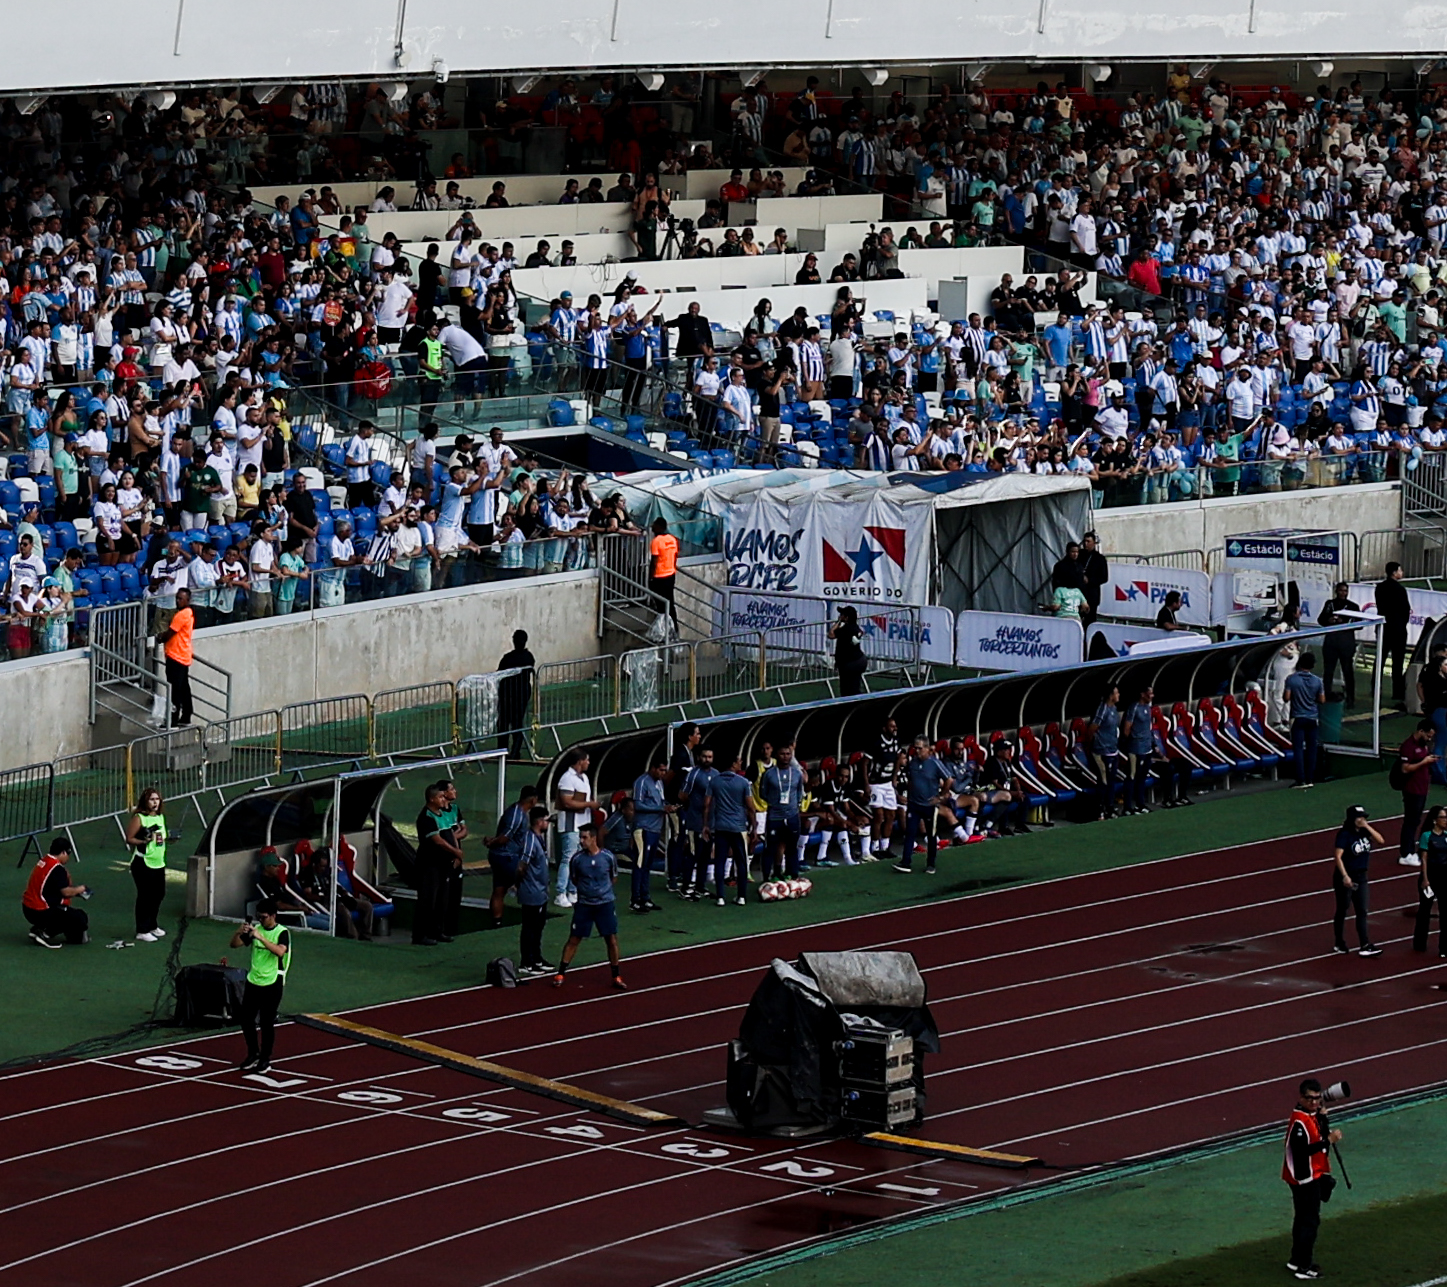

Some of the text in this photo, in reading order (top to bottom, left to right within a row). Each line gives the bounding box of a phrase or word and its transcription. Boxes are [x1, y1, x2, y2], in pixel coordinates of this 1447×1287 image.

[725, 528, 805, 564] VAMOS
[1244, 542, 1283, 556] Estácio
[1300, 549, 1334, 562] Estácio
[886, 587, 903, 598] DO
[996, 625, 1044, 643] #VAMOS
[978, 638, 1061, 660] TORCERJUNTOS
[135, 1055, 203, 1070] 8
[241, 1073, 308, 1089] 7
[442, 1107, 513, 1123] 5
[543, 1124, 606, 1140] 4
[660, 1142, 731, 1159] 3
[758, 1160, 836, 1178] 2
